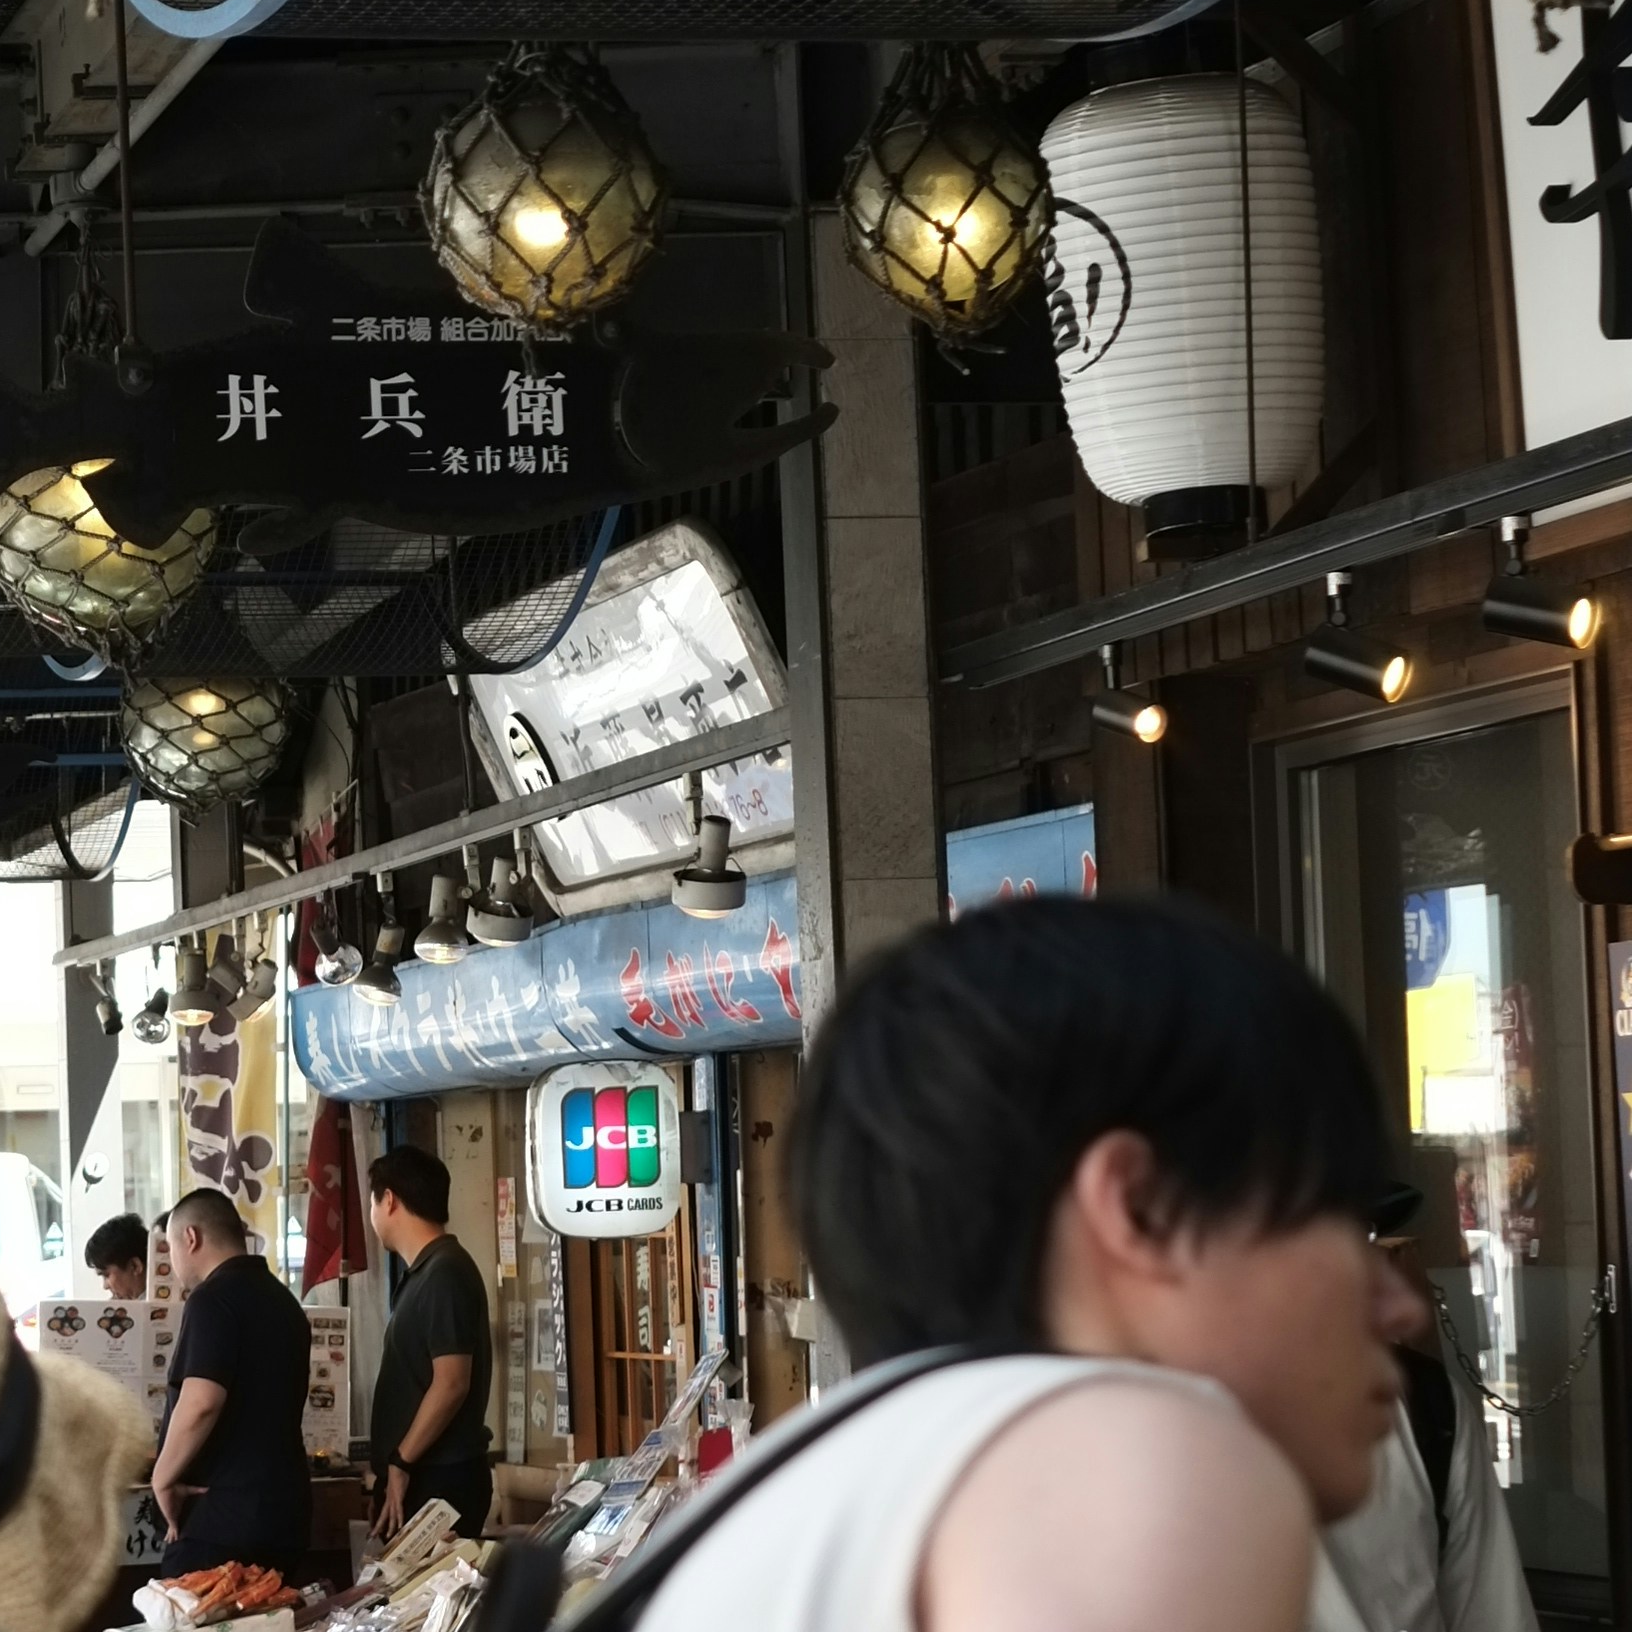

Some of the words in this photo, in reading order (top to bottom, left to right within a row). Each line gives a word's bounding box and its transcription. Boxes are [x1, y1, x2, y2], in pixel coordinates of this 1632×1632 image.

[330, 316, 432, 343] 二条市場
[215, 368, 569, 443] 丼兵衛
[407, 443, 570, 475] 二条市場店
[565, 1125, 658, 1150] JCB
[566, 1198, 624, 1213] JCB
[627, 1196, 663, 1211] CARDS
